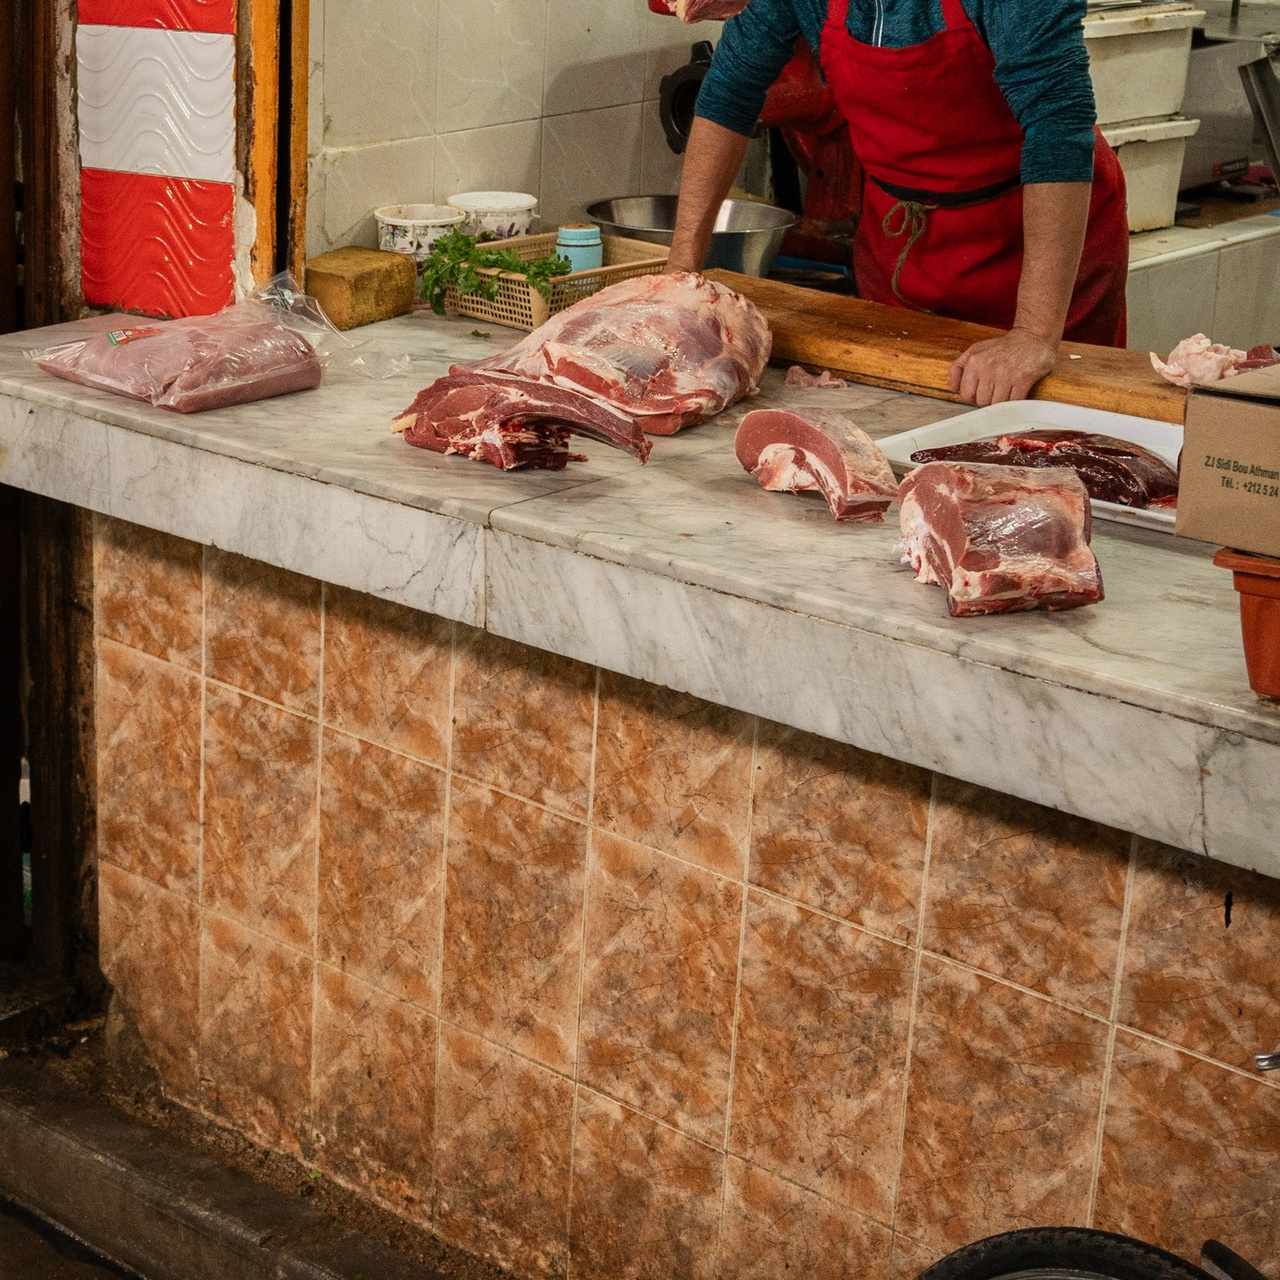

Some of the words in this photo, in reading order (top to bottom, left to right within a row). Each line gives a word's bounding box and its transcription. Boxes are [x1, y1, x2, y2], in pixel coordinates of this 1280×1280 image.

[1216, 457, 1232, 471] Sidi
[1232, 460, 1249, 474] Bou
[1249, 464, 1280, 480] Athman
[1243, 481, 1261, 495] +212
[1262, 484, 1269, 496] 5
[1269, 486, 1279, 498] 24
